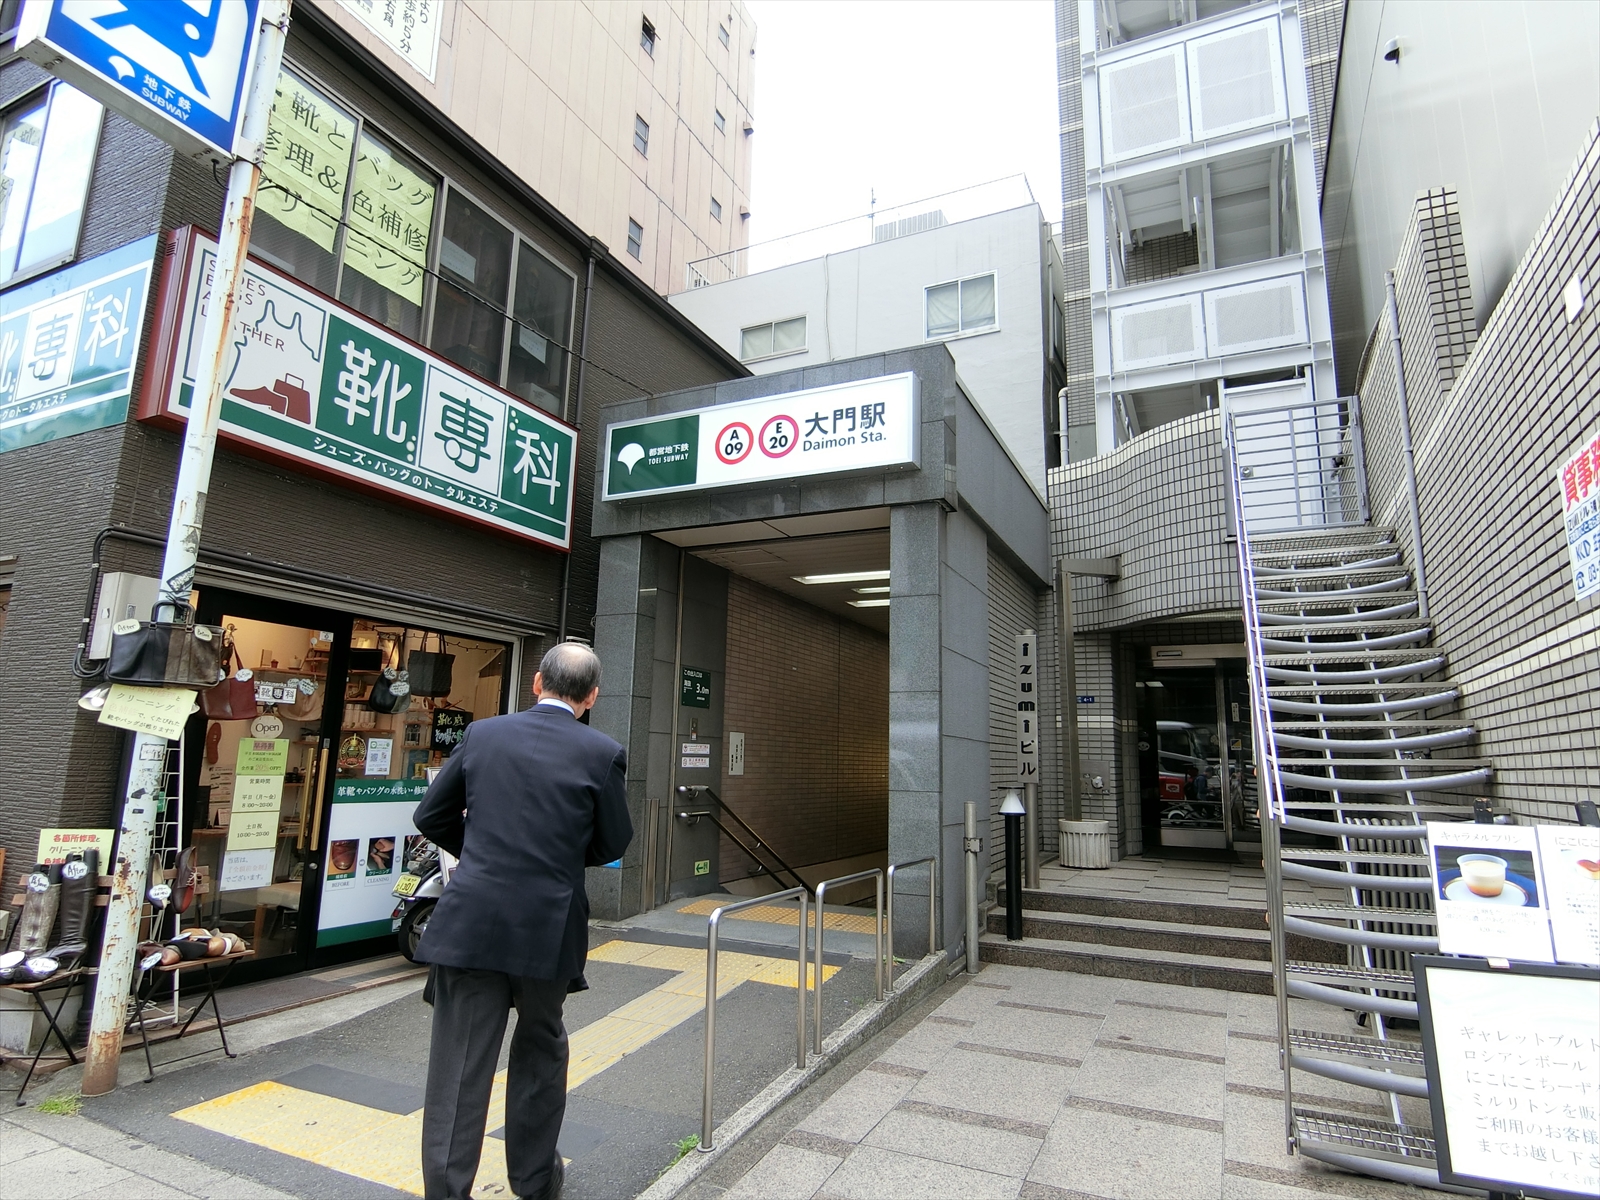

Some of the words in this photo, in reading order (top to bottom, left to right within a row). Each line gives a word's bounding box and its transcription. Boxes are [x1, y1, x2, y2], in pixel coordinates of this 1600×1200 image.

[143, 74, 192, 113] 地下鉄
[141, 87, 189, 121] SUBWAY
[333, 339, 561, 506] 靴専科
[804, 401, 886, 438] 大門駅
[729, 429, 740, 441] A
[775, 422, 783, 434] E
[725, 441, 744, 456] 09
[769, 434, 789, 450] 20
[803, 433, 856, 452] Daimon
[860, 430, 887, 444] Sta.
[649, 442, 689, 457] 都営地下鉄
[648, 457, 662, 465] TOEI
[663, 453, 689, 463] SUBWAY
[313, 436, 499, 513] シューズ・バッグのトータルエステ
[255, 723, 280, 735] Open
[367, 876, 389, 884] CLEANING
[1464, 1050, 1588, 1072] ロシアンボール
